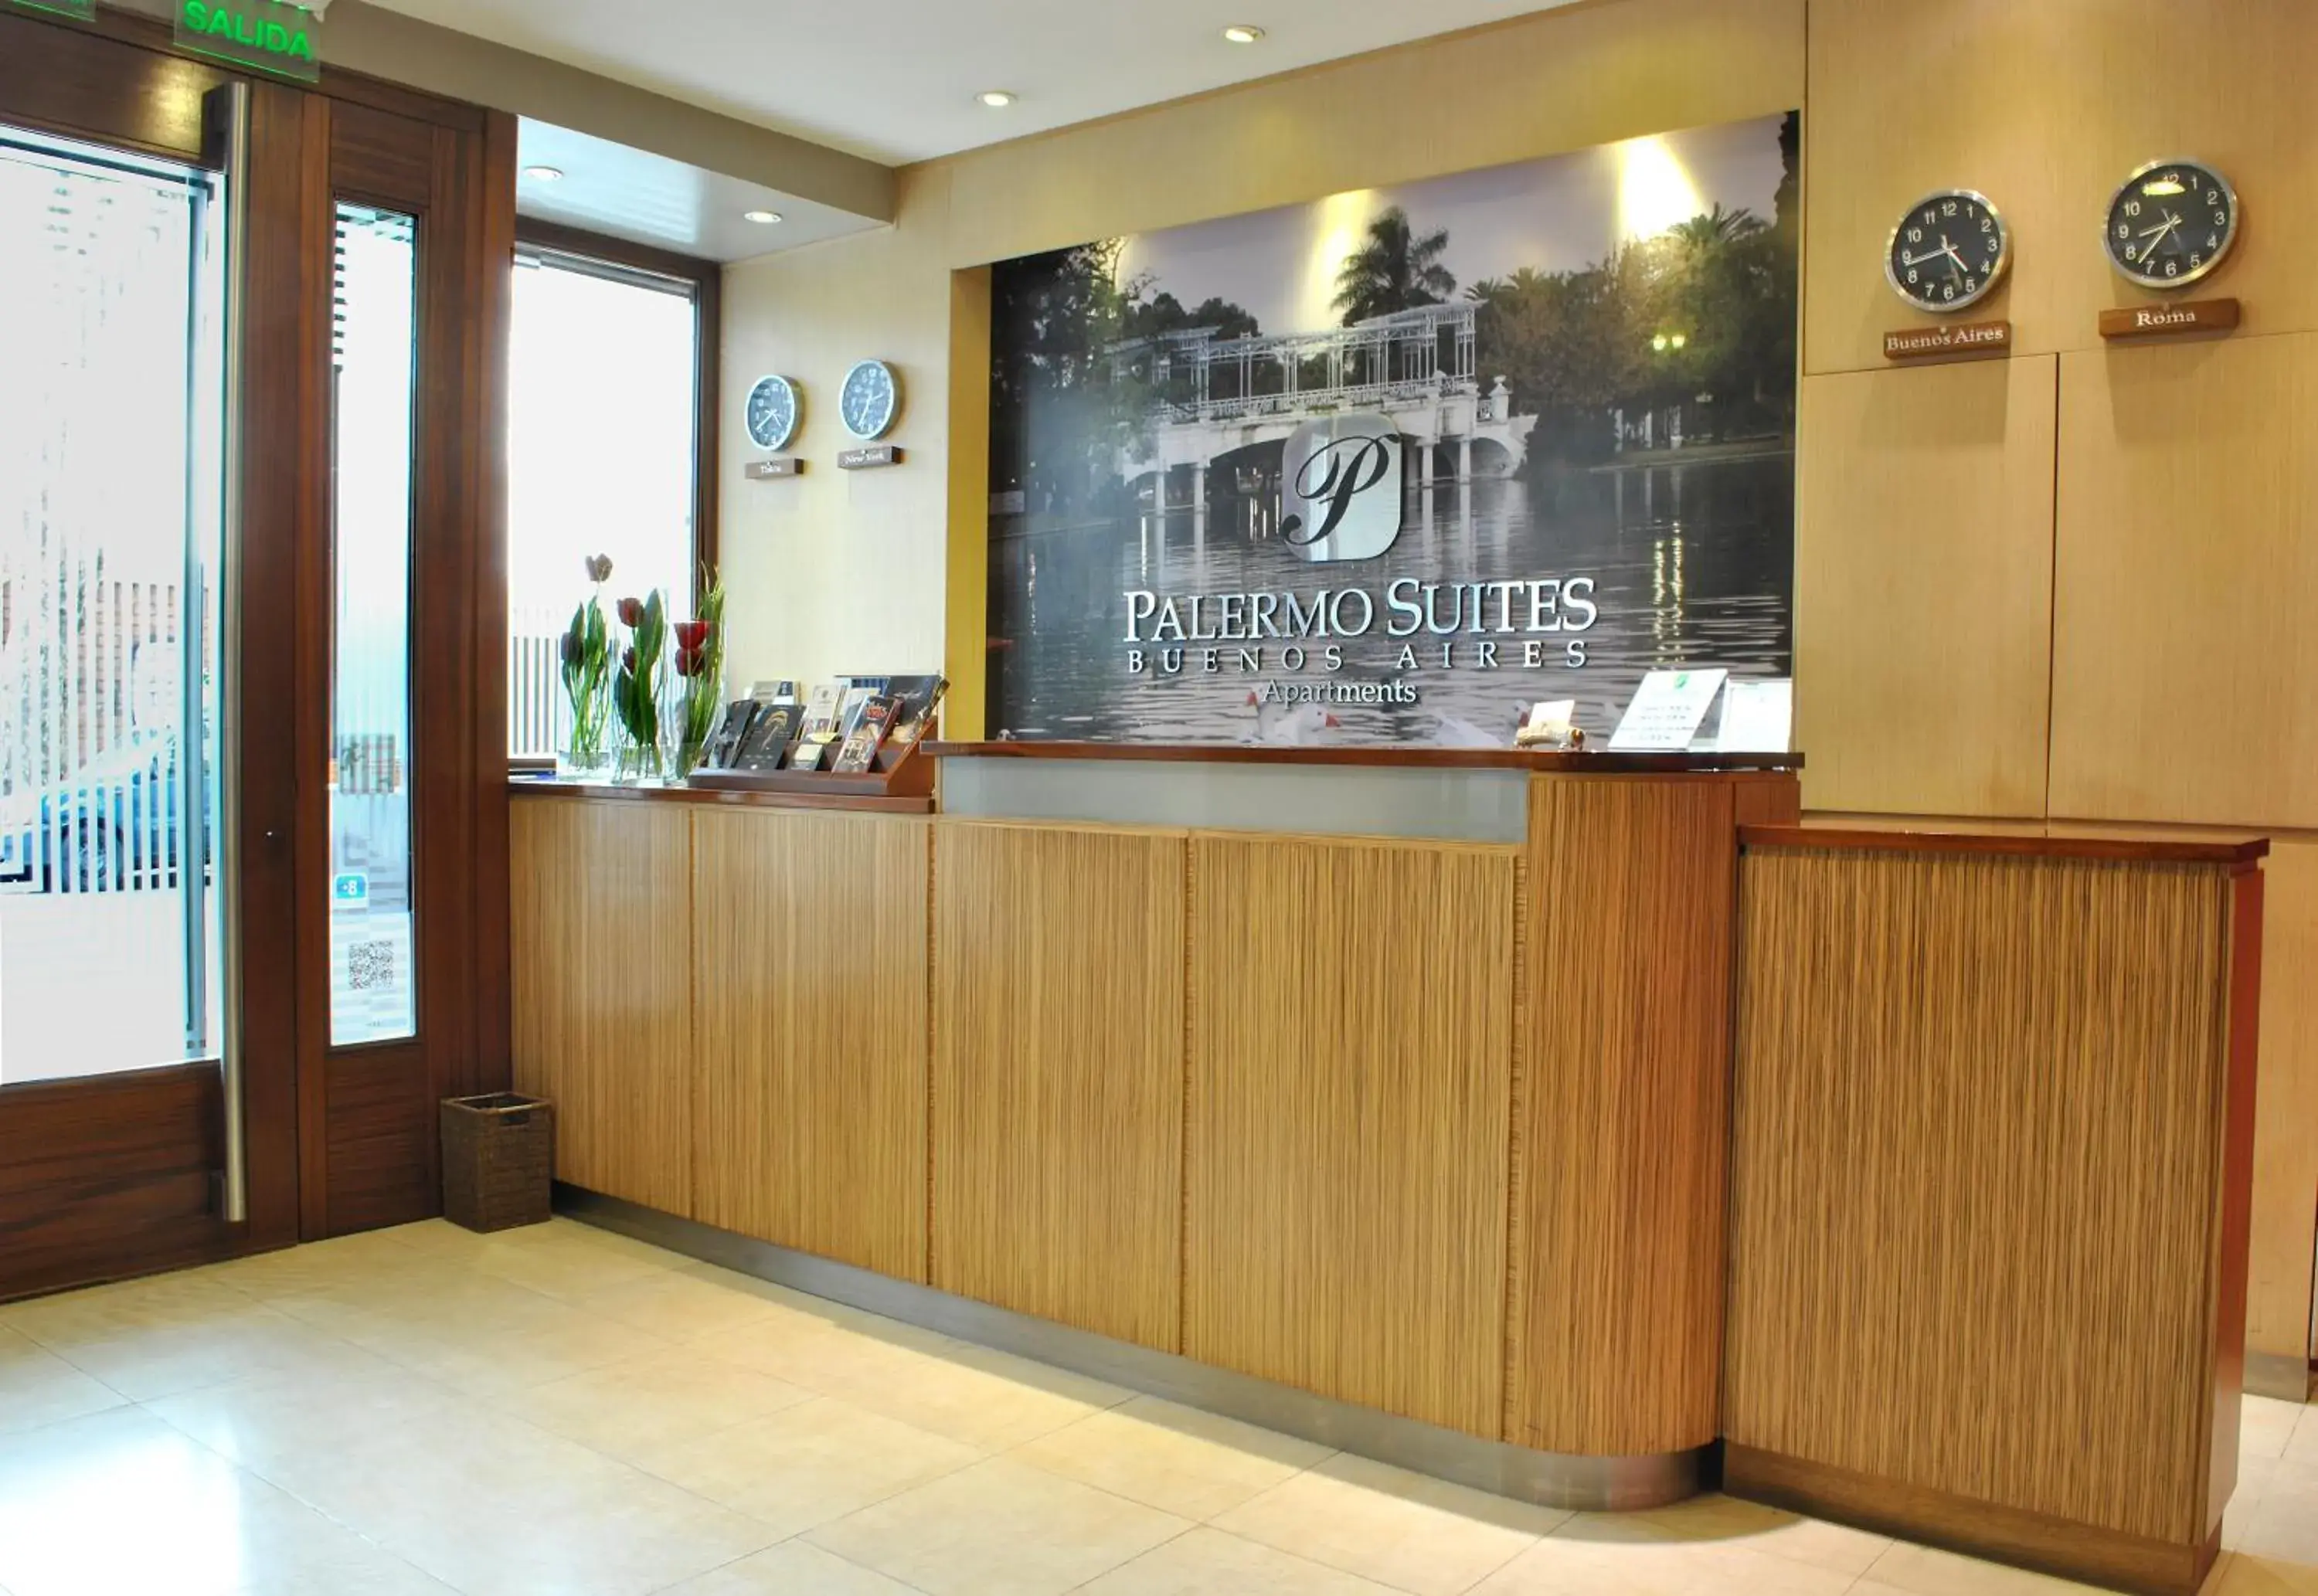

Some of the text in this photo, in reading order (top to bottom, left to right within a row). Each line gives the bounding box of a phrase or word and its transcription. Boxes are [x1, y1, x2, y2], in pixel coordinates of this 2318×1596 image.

[184, 1, 314, 62] SALIDA
[2207, 191, 2218, 205] 2
[1942, 202, 1957, 216] 12
[1967, 205, 1973, 219] 1
[2125, 202, 2140, 216] 10
[1924, 211, 1936, 224] 11
[2215, 212, 2225, 226] 3
[1981, 219, 1991, 233] 2
[2119, 225, 2129, 239] 9
[1907, 229, 1922, 242] 10
[2207, 235, 2217, 249] 4
[1987, 237, 1997, 252] 3
[2126, 246, 2136, 260] 8
[1980, 260, 1990, 273] 4
[2146, 260, 2155, 274] 7
[2190, 254, 2201, 268] 5
[2166, 262, 2177, 277] 6
[1908, 270, 1917, 284] 8
[1925, 284, 1934, 297] 7
[1966, 278, 1975, 293] 5
[1943, 286, 1954, 300] 6
[2136, 310, 2197, 327] Roma
[1886, 327, 2004, 350] Buenos Aires
[1123, 578, 1598, 642] PALERMO SUITES
[1127, 640, 1587, 673] BUENOS AIRES
[1263, 678, 1416, 709] Apartments
